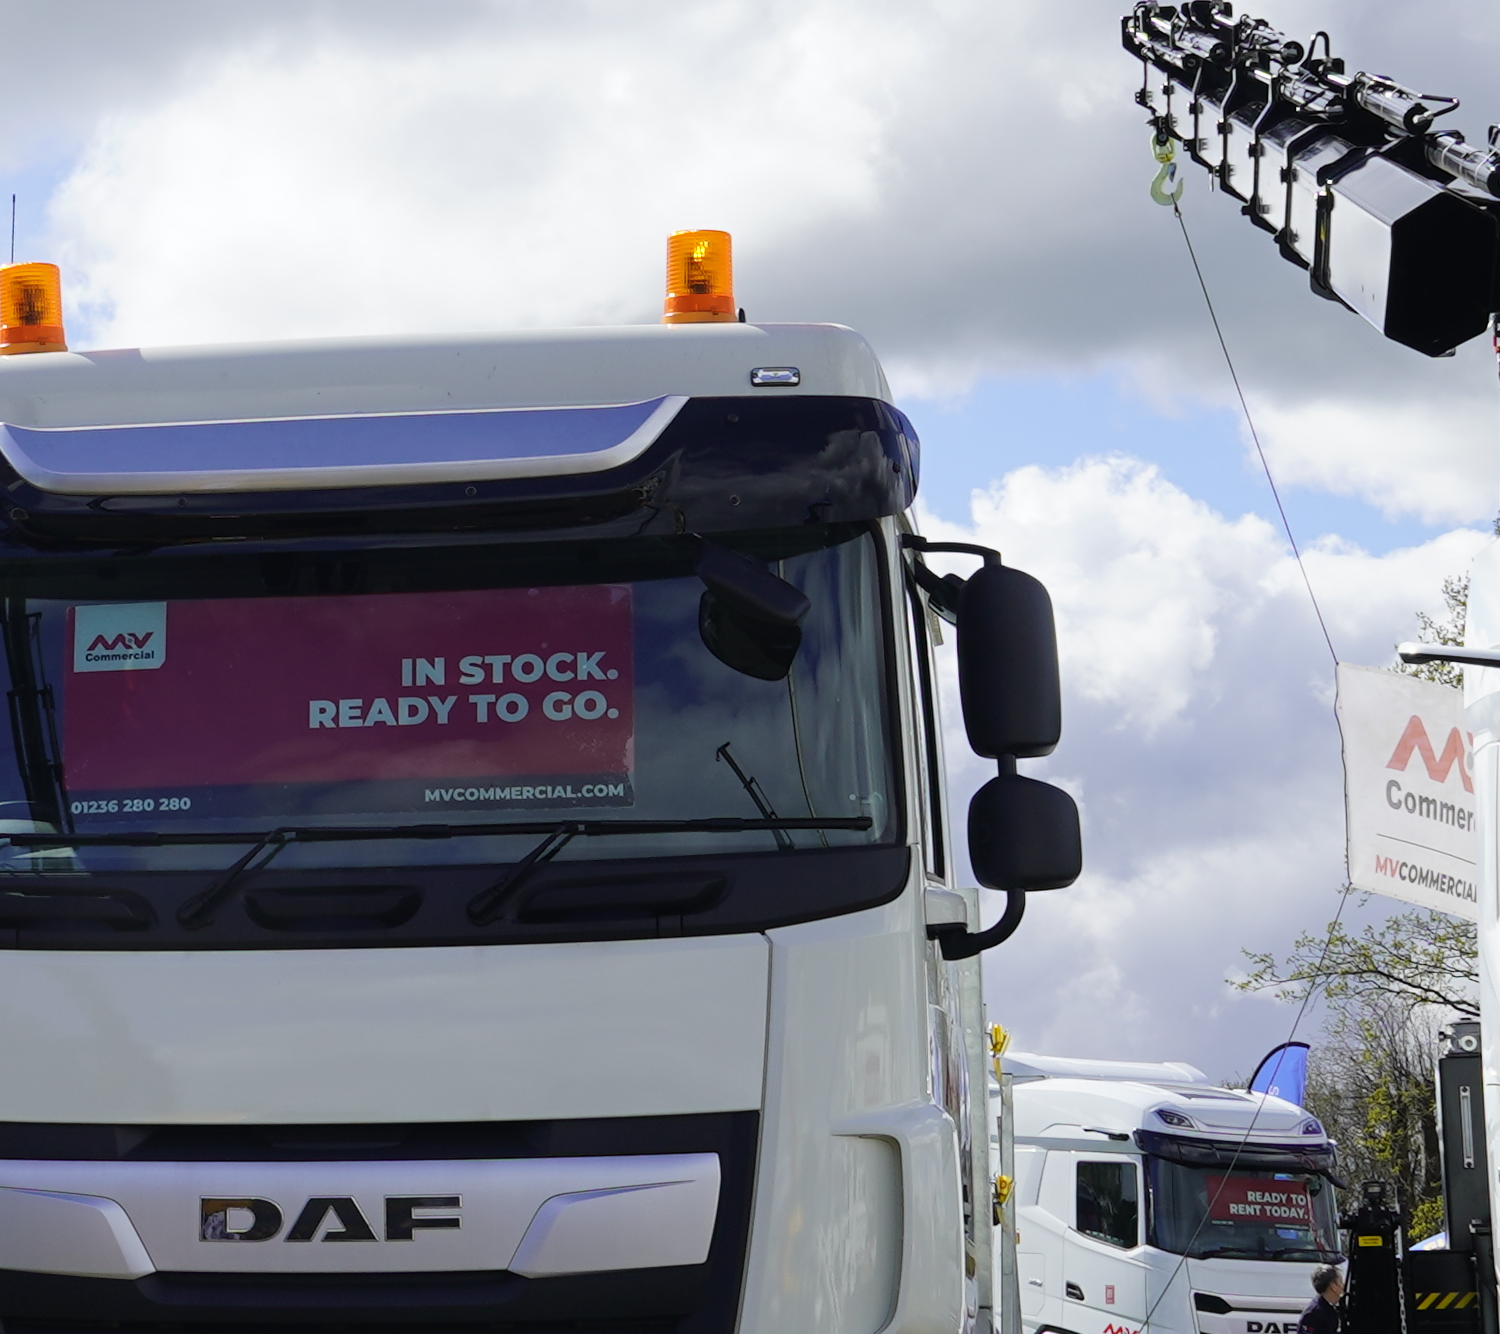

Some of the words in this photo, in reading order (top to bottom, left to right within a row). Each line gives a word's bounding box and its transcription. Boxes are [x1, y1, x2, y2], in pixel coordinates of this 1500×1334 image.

[85, 649, 155, 663] Commercial
[402, 657, 445, 687] IN
[458, 651, 619, 685] STOCK.
[308, 696, 459, 728] READY
[469, 693, 528, 723] TO
[542, 690, 619, 721] GO.
[424, 782, 624, 802] MVCOMMERCIAL.COM
[70, 800, 118, 814] 01236
[122, 799, 155, 813] 280
[159, 797, 191, 811] 280
[1386, 779, 1476, 832] Commer
[1247, 1191, 1287, 1204] READY
[1289, 1193, 1306, 1206] TO
[199, 1193, 463, 1242] DAF
[1229, 1203, 1262, 1216] RENT
[1264, 1205, 1308, 1219] TODAY.
